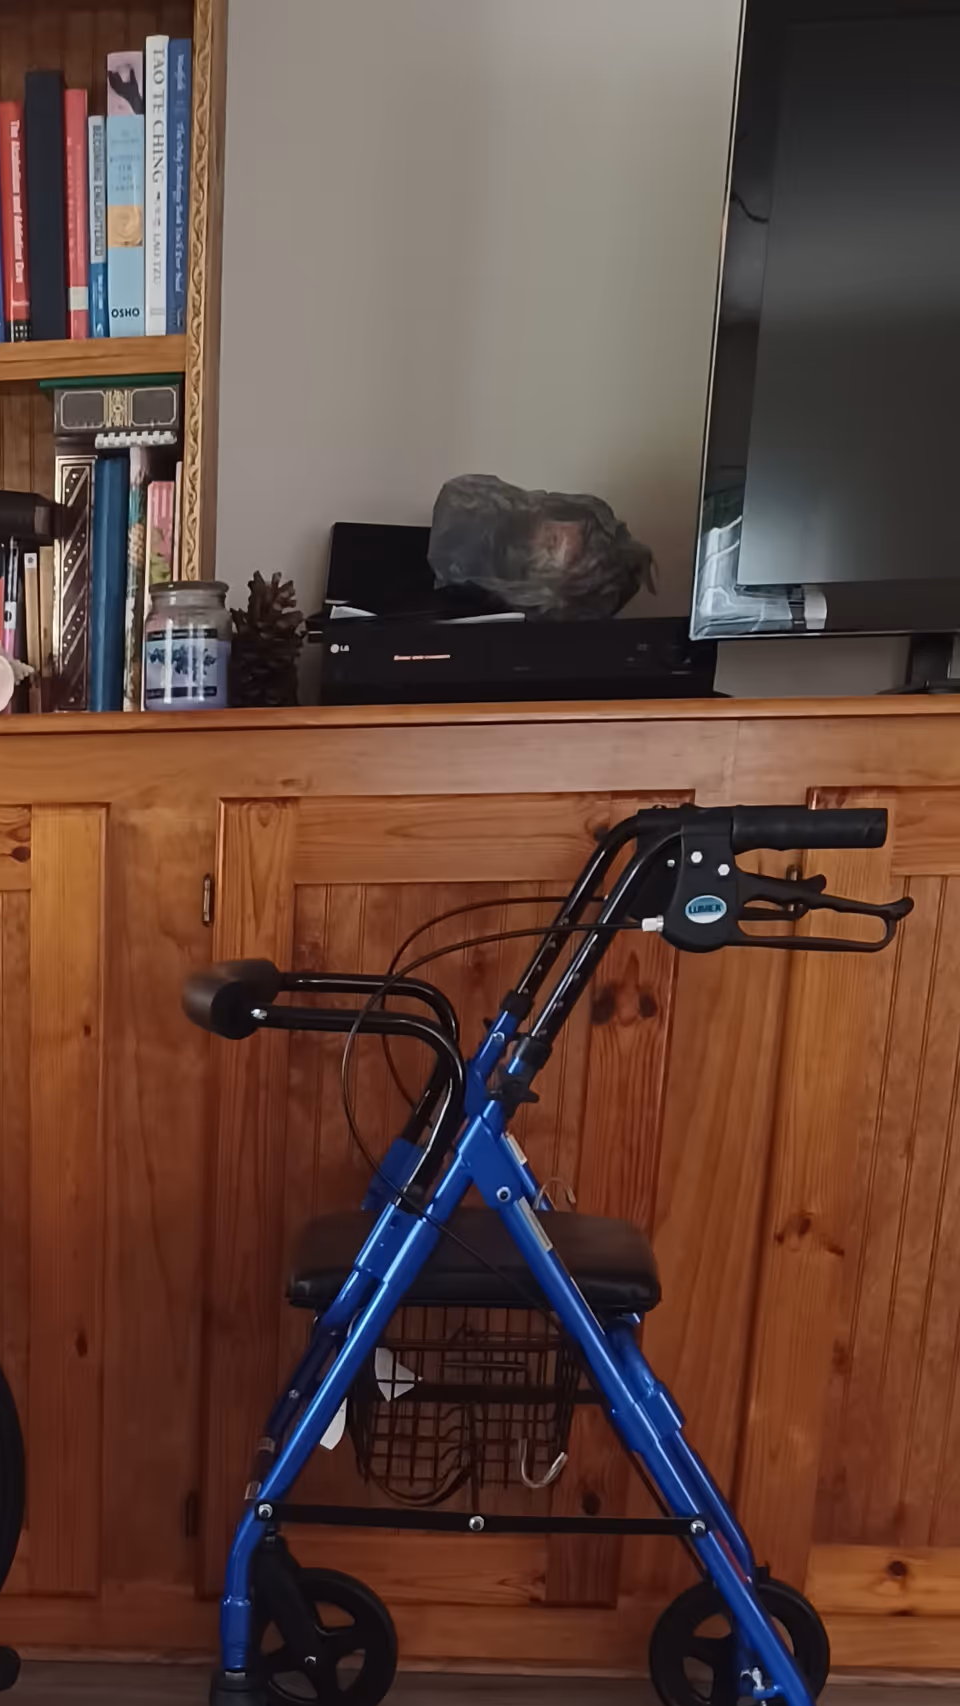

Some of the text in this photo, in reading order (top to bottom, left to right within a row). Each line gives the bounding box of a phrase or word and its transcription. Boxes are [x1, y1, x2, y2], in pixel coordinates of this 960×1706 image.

[152, 48, 165, 184] TAO TE CHING
[92, 125, 104, 256] BECOMING ENLIGHTENED
[111, 307, 140, 318] OSHO
